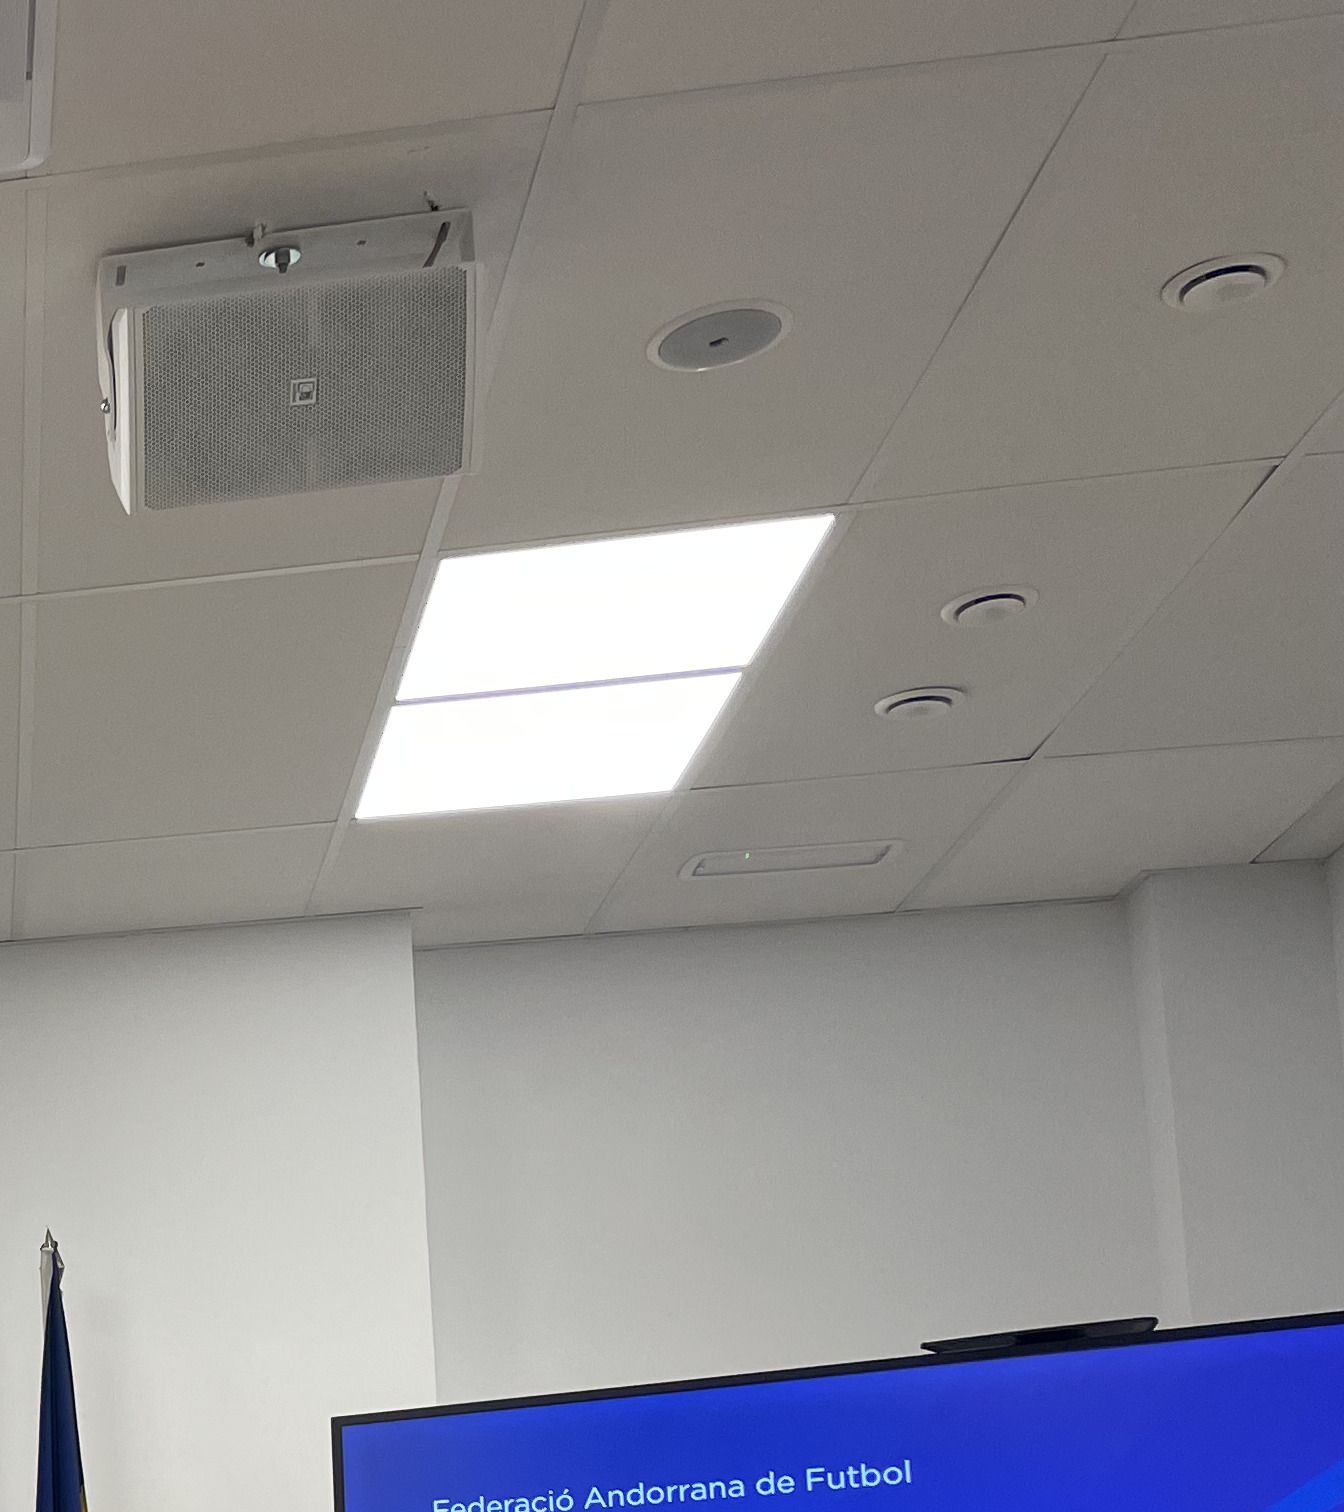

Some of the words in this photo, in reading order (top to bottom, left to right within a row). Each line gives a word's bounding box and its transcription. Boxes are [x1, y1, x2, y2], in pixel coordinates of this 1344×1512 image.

[583, 1480, 745, 1510] Andorrana
[755, 1470, 796, 1496] de
[805, 1459, 912, 1492] Futbol
